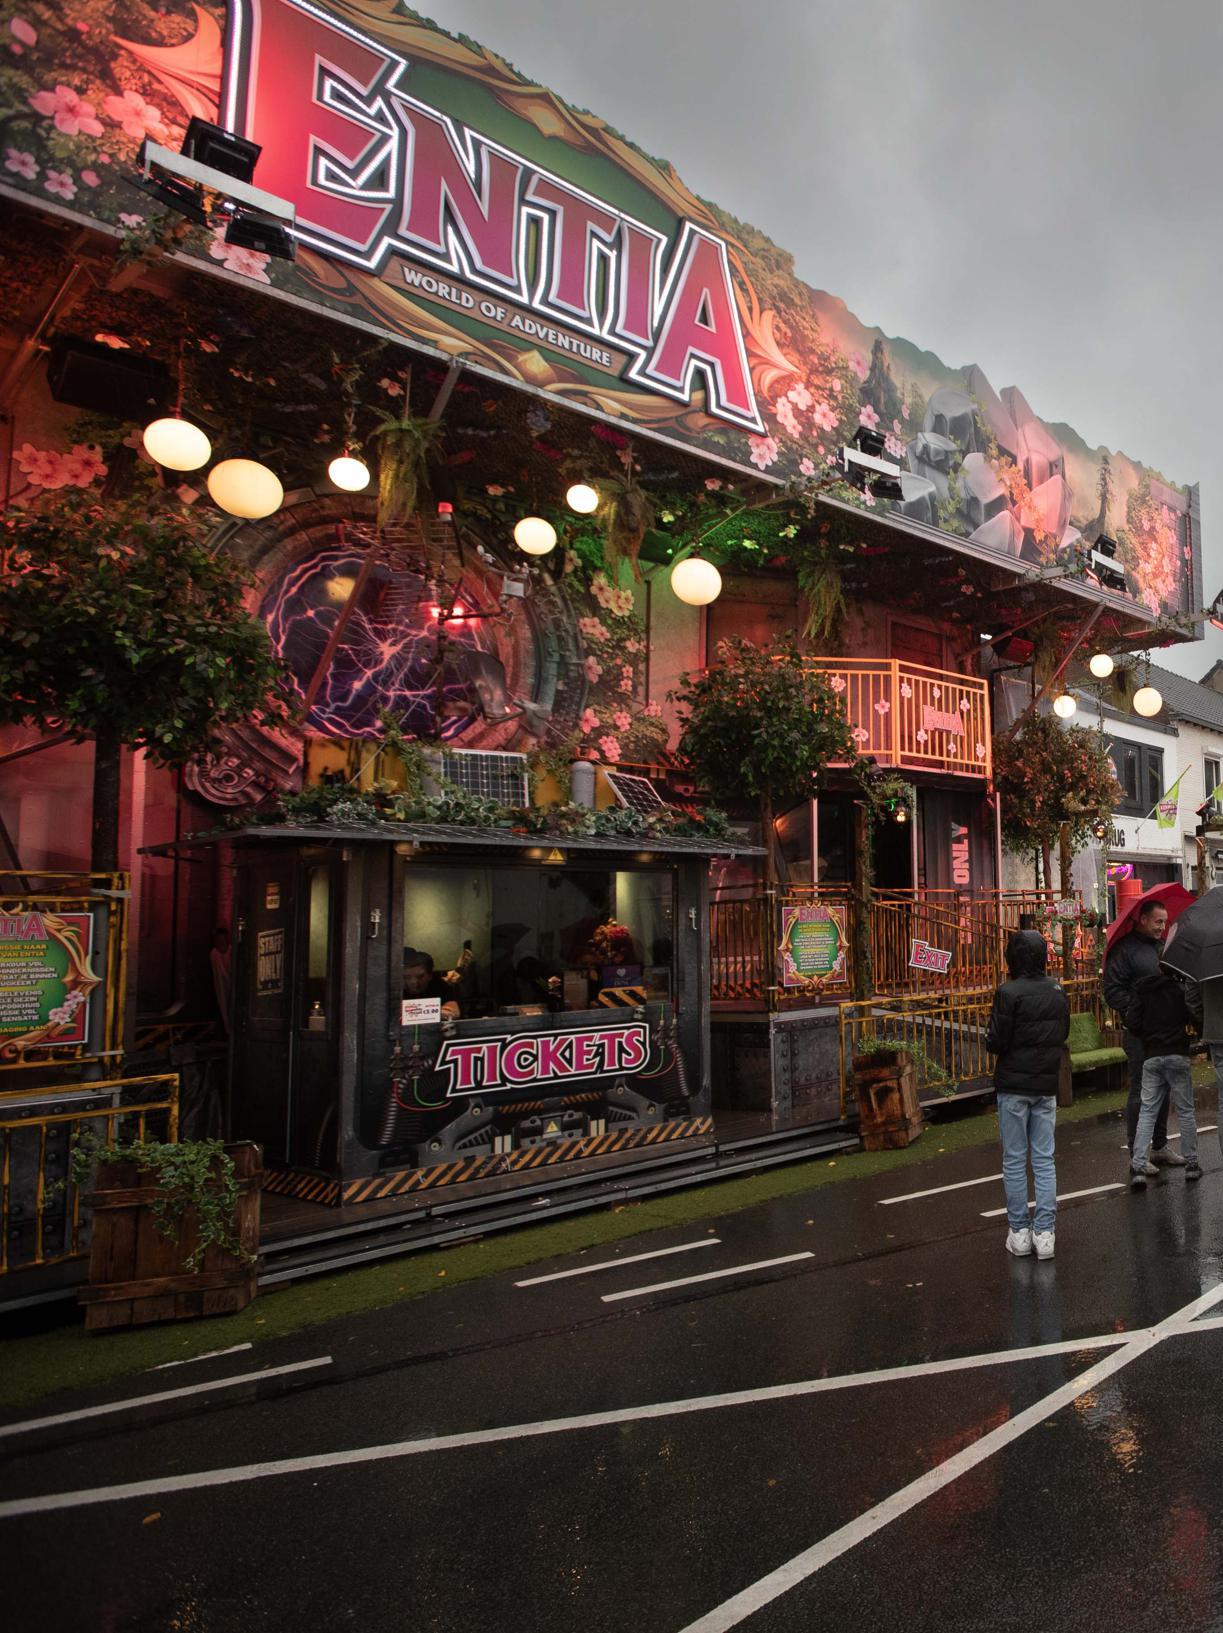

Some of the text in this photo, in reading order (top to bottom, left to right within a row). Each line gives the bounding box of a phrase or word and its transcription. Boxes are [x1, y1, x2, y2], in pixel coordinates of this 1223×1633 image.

[244, 0, 757, 421] ENTIA
[402, 267, 611, 368] WORLD OF ADVENTURE
[951, 822, 970, 884] ONLY
[913, 943, 950, 970] EXIT
[444, 1027, 645, 1090] TICKETS
